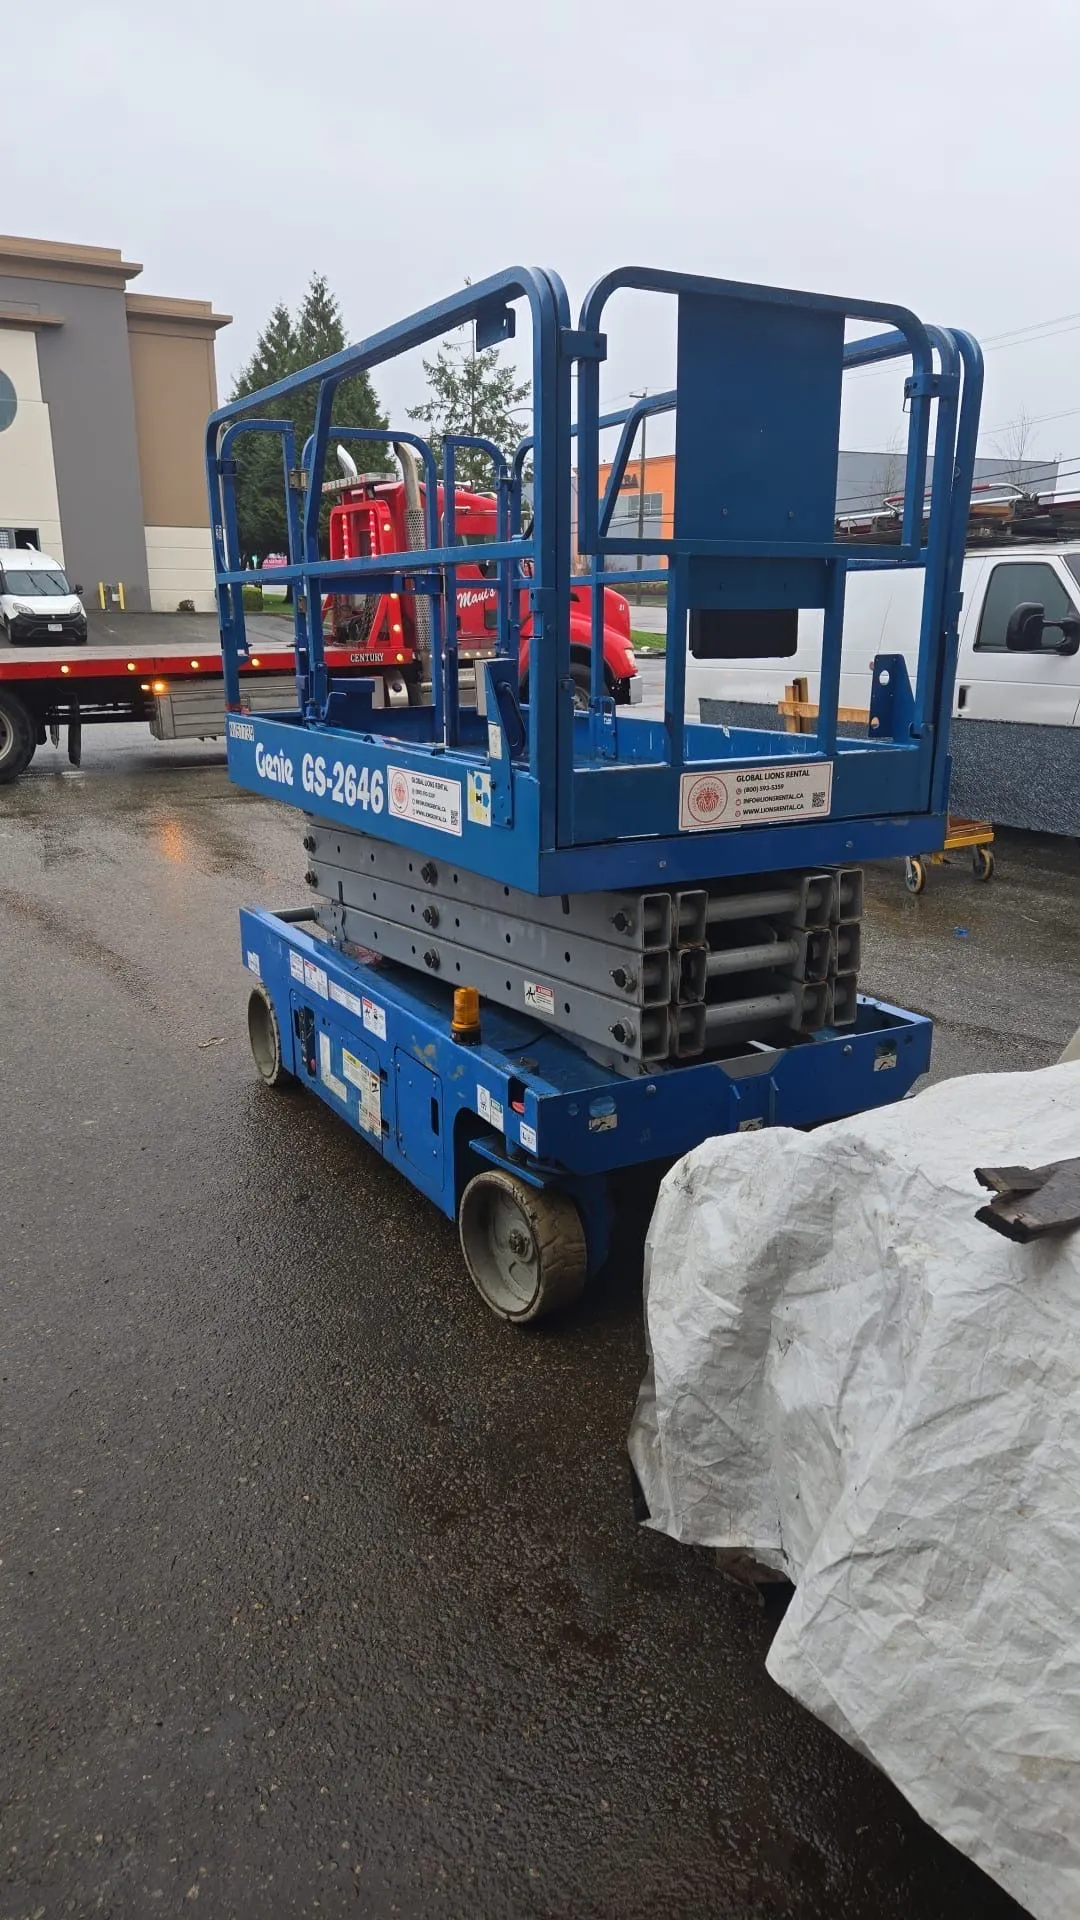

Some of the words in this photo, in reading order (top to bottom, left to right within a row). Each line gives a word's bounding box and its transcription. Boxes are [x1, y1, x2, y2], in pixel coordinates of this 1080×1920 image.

[350, 652, 384, 663] CENTURY
[255, 742, 294, 786] Genie
[302, 752, 384, 814] GS-2646
[736, 772, 763, 783] GLOBAL
[764, 770, 784, 780] LIONS
[786, 769, 810, 778] RENTAL
[742, 803, 804, 816] WWW.LIONSRENTAL.CA
